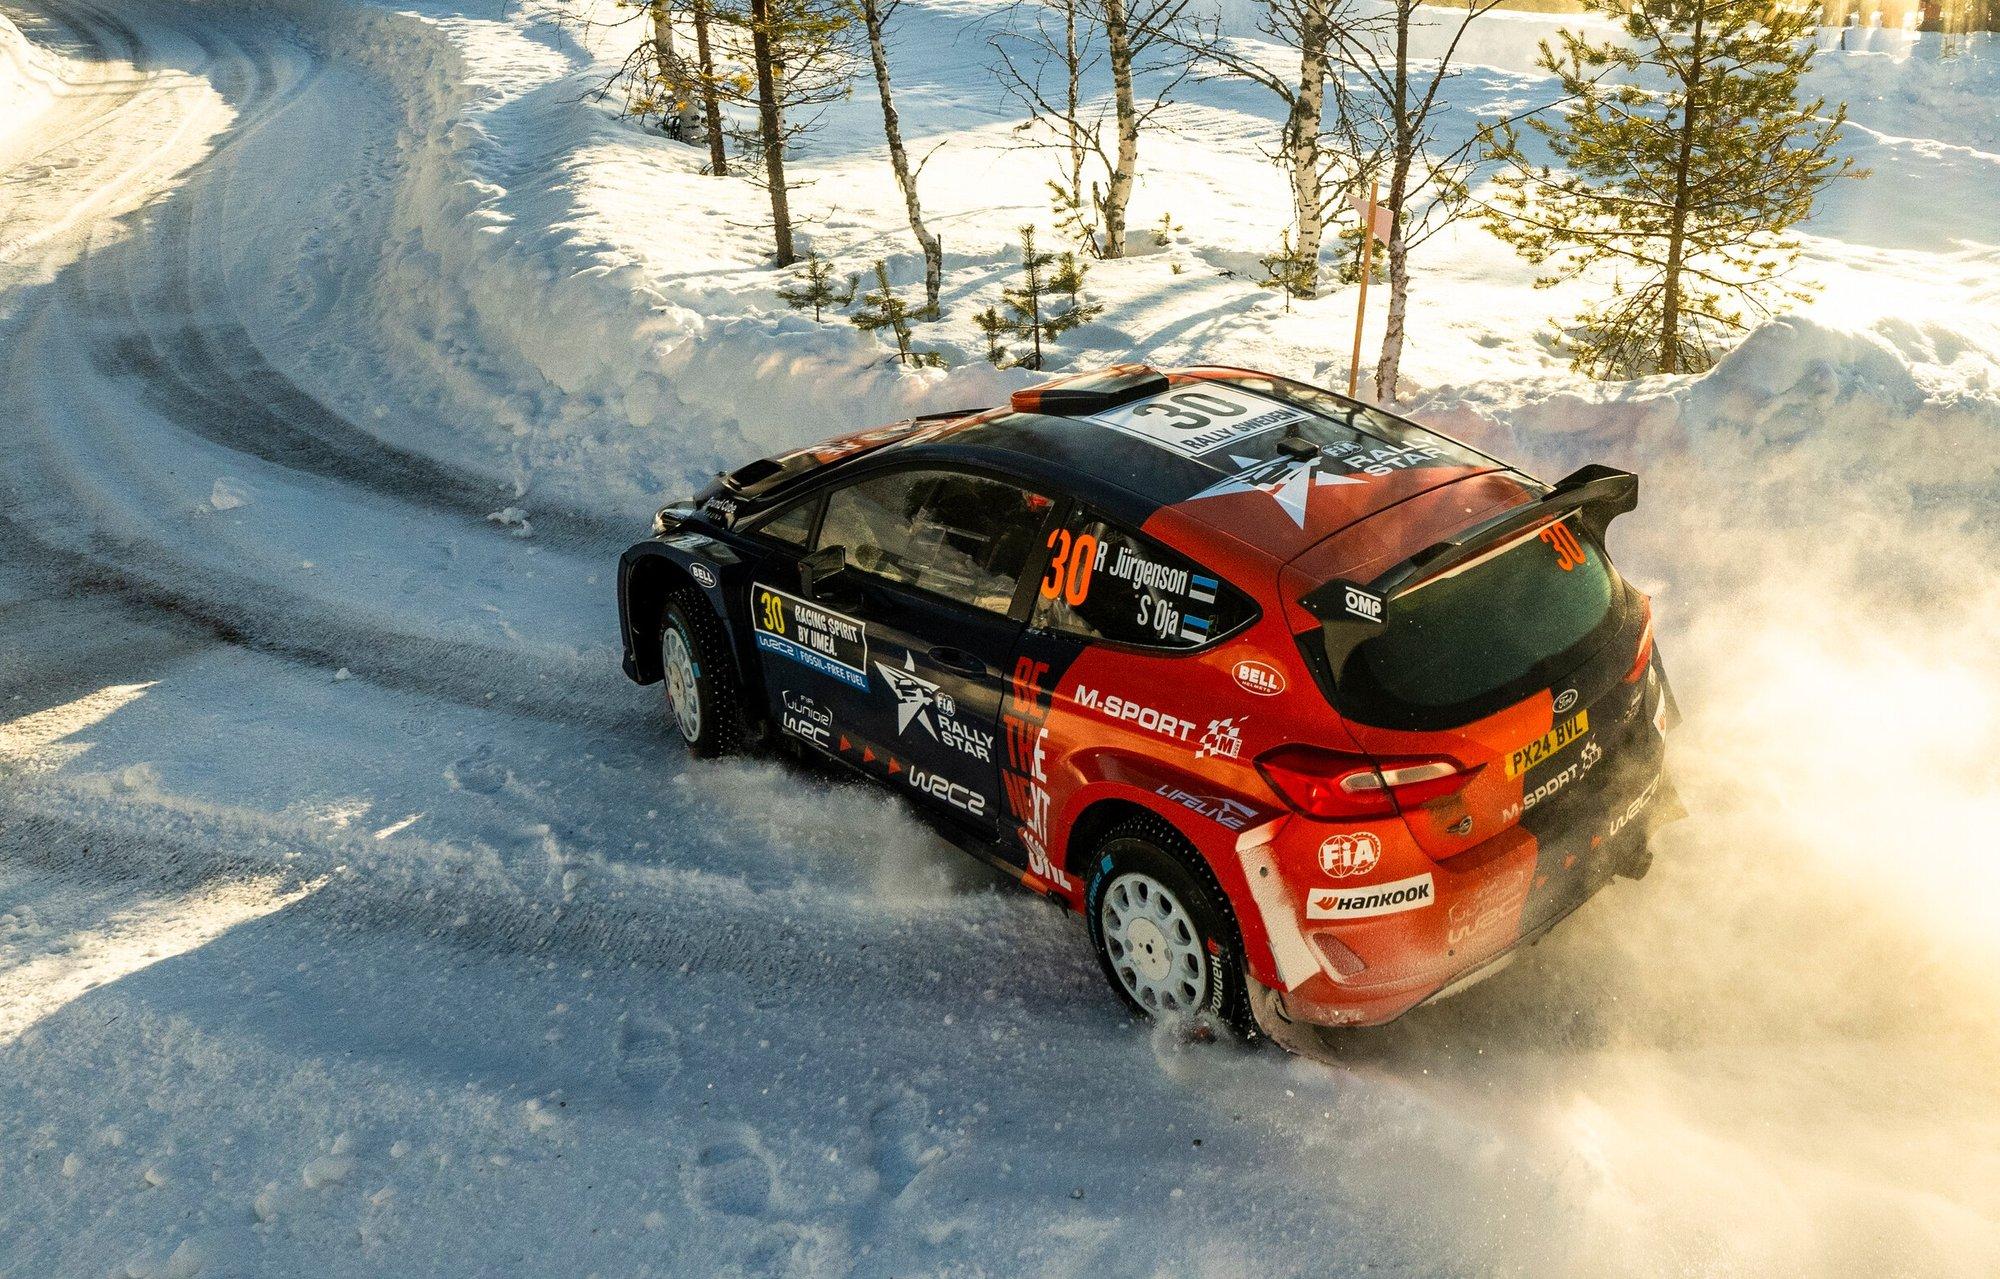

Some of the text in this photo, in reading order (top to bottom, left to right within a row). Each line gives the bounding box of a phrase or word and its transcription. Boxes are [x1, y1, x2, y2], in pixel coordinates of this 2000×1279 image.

[1132, 392, 1248, 430] 30
[1180, 408, 1298, 450] RALLY SWEDEN
[1343, 436, 1439, 468] RALLY
[1364, 447, 1450, 477] STAR
[1538, 520, 1586, 572] 30
[692, 566, 713, 583] BELL
[1040, 528, 1097, 606] 30
[1093, 541, 1189, 596] R Jürgenson
[761, 592, 785, 634] 30
[794, 604, 858, 643] RACING SPIRIT
[1136, 594, 1179, 640] S Oja
[1345, 591, 1382, 617] OMP
[797, 625, 809, 645] BY
[799, 651, 866, 688] FOSSIL-FREE FUEL
[1012, 656, 1050, 719] BE
[1238, 665, 1279, 690] BELL
[1073, 684, 1197, 741] M-SPORT
[1557, 691, 1575, 709] Ford
[784, 712, 831, 748] WRC
[938, 714, 994, 750] RALLY
[941, 731, 991, 764] STAR
[1003, 713, 1049, 784] THE
[1512, 733, 1551, 775] PX24
[1555, 715, 1584, 746] BVL
[909, 765, 985, 816] WRC2
[1001, 767, 1051, 848] NEXT
[1502, 764, 1578, 823] M-SPORT
